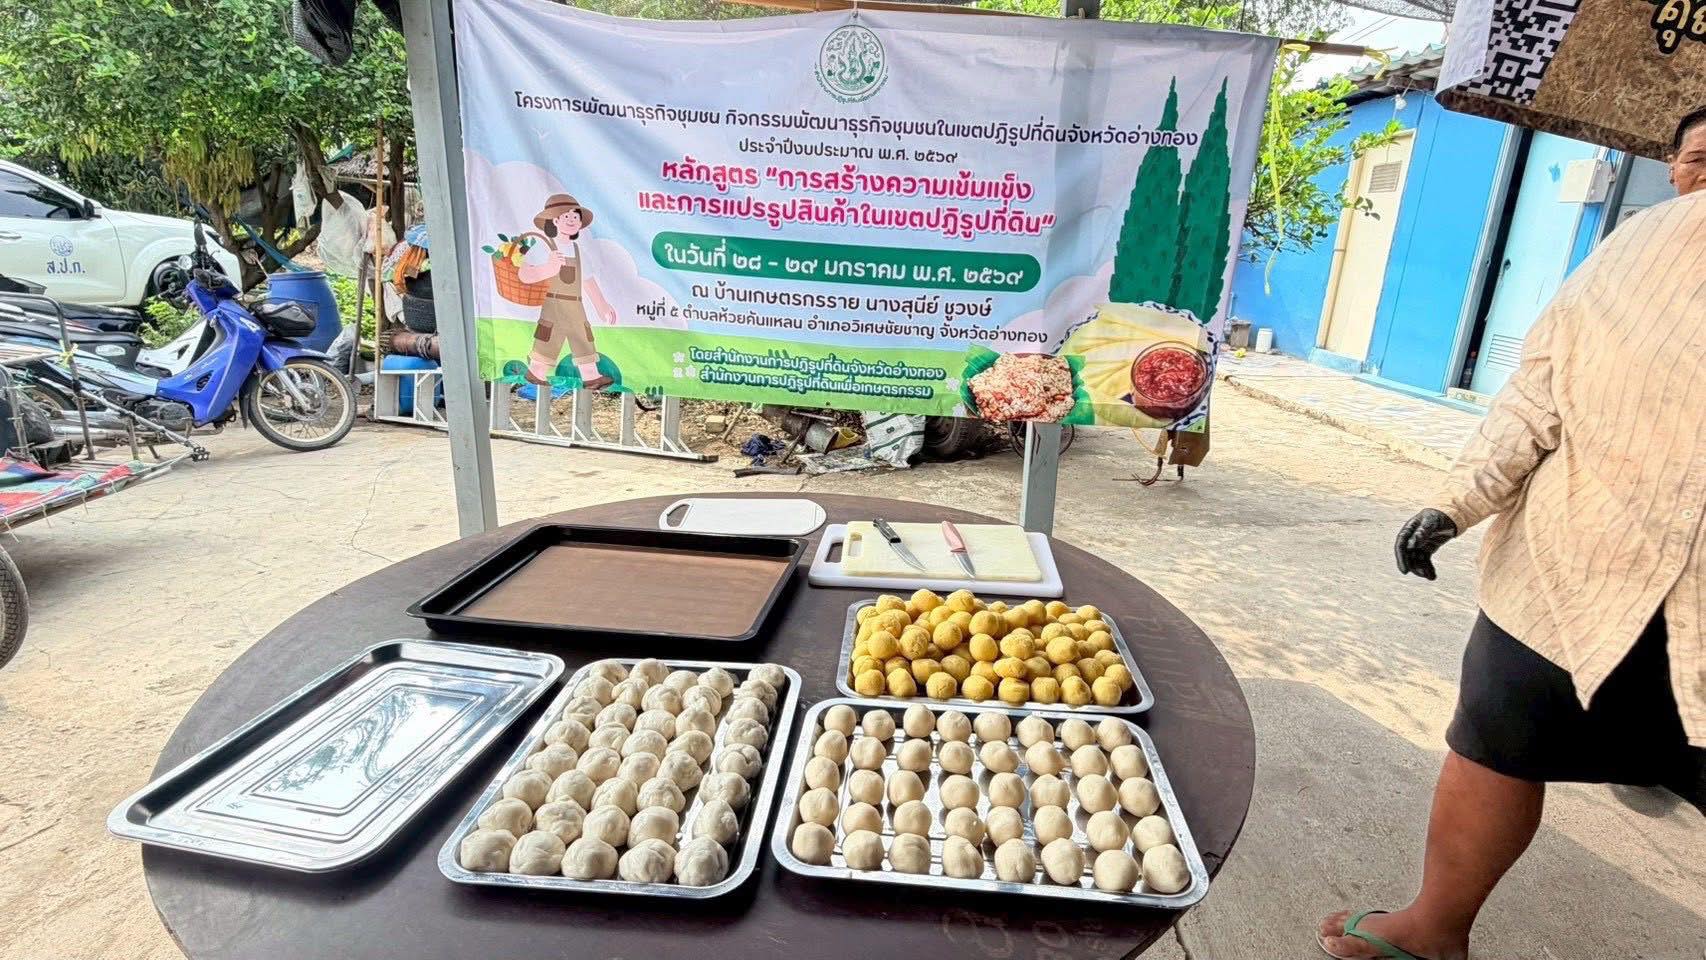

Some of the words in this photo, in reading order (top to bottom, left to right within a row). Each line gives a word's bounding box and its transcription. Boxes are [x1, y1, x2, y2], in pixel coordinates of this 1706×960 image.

[514, 91, 720, 128] โครงการพัฒนาธุรกิจชุมชน
[726, 109, 1198, 147] กิจกรรมพัฒนาธุรกิจชุมชนในเขตปฏิรูปที่ดินจังหวัดอ่างทอง
[739, 137, 873, 159] ประจำปีงบประมาณ
[878, 148, 909, 161] พ.ศ.
[915, 150, 958, 164] ๒๕๖๙
[662, 156, 758, 191] หลักสูตร
[47, 258, 86, 274] ส.ป.ก.
[664, 238, 727, 268] ในวันที่
[732, 255, 762, 271] ๒๘
[785, 256, 818, 274] ๒๙
[824, 259, 906, 281] มกราคม
[913, 266, 956, 283] พ.ศ.
[963, 268, 1024, 285] ๒๕๖๙
[692, 284, 708, 298] ณ
[714, 281, 860, 310] บ้านเกษตรกรราย
[866, 295, 940, 319] นางสุนีย์
[944, 297, 992, 321] ชูวงษ์
[636, 297, 666, 321] หมู่ที่
[670, 307, 679, 318] ๕
[682, 303, 803, 329] ตำบลห้วยคันแหลน
[807, 315, 935, 339] อำเภอวิเศษชัยชาญ
[939, 323, 1048, 343] จังหวัดอ่างทอง
[690, 347, 945, 379] โดยสำนักงานการปฏิรูปที่ดินจังหวัดอ่างทอง
[701, 366, 932, 397] สำนักงานการปฏิรูปที่ดินเพื่อเกษตรกรรม
